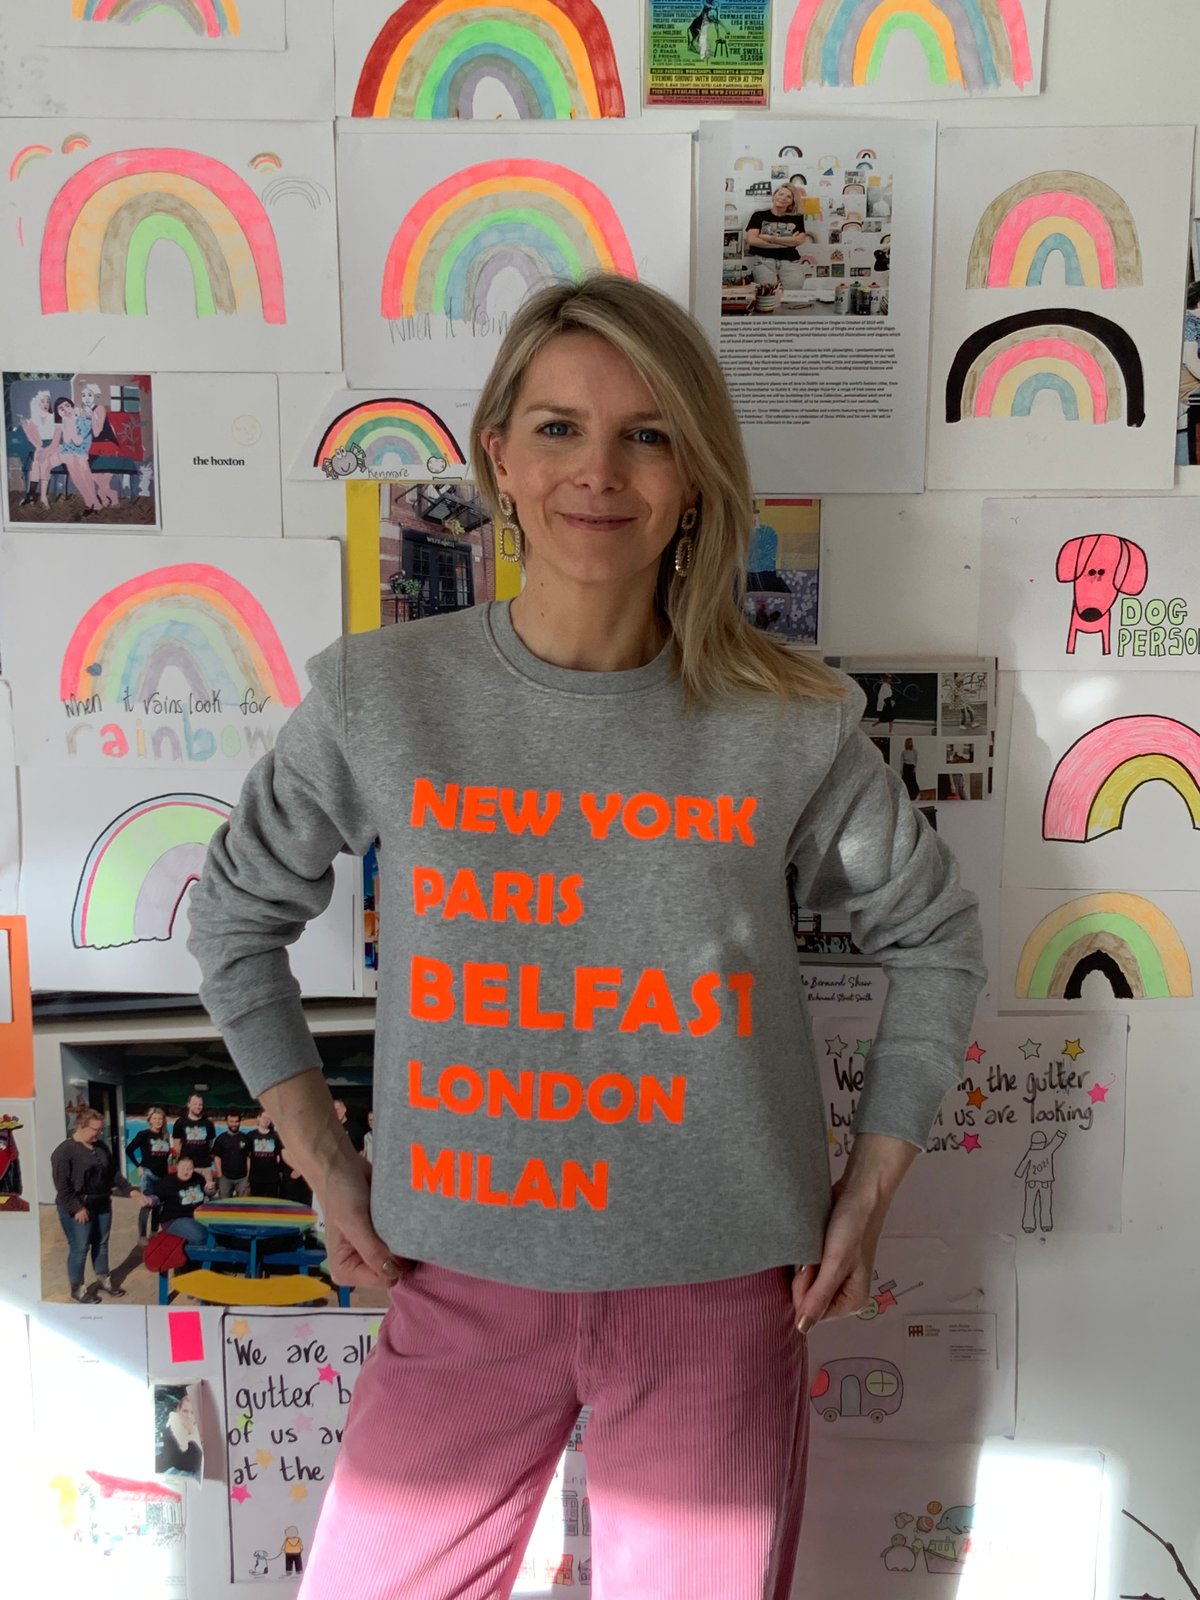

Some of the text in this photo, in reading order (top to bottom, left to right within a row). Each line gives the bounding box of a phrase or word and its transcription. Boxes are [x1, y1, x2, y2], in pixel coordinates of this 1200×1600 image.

[193, 456, 246, 466] the hoxton
[1120, 597, 1188, 626] DOG
[1118, 626, 1200, 657] PERSO
[123, 686, 133, 714] it
[144, 692, 184, 715] rains
[190, 690, 222, 715] look
[240, 688, 272, 716] for
[410, 778, 758, 847] NEW YORK
[412, 865, 585, 926] PARIS
[410, 954, 755, 1038] BELFAST
[408, 1059, 687, 1124] LONDON
[832, 1056, 864, 1092] We
[986, 1064, 1018, 1093] the
[1022, 1061, 1090, 1104] gutter
[954, 1109, 976, 1126] us
[984, 1104, 1018, 1126] are
[1030, 1100, 1094, 1131] looking
[410, 1142, 609, 1211] MILAN
[286, 1340, 328, 1364] are
[343, 1334, 372, 1366] all
[228, 1420, 344, 1446] of us ar
[234, 1456, 325, 1485] at the
